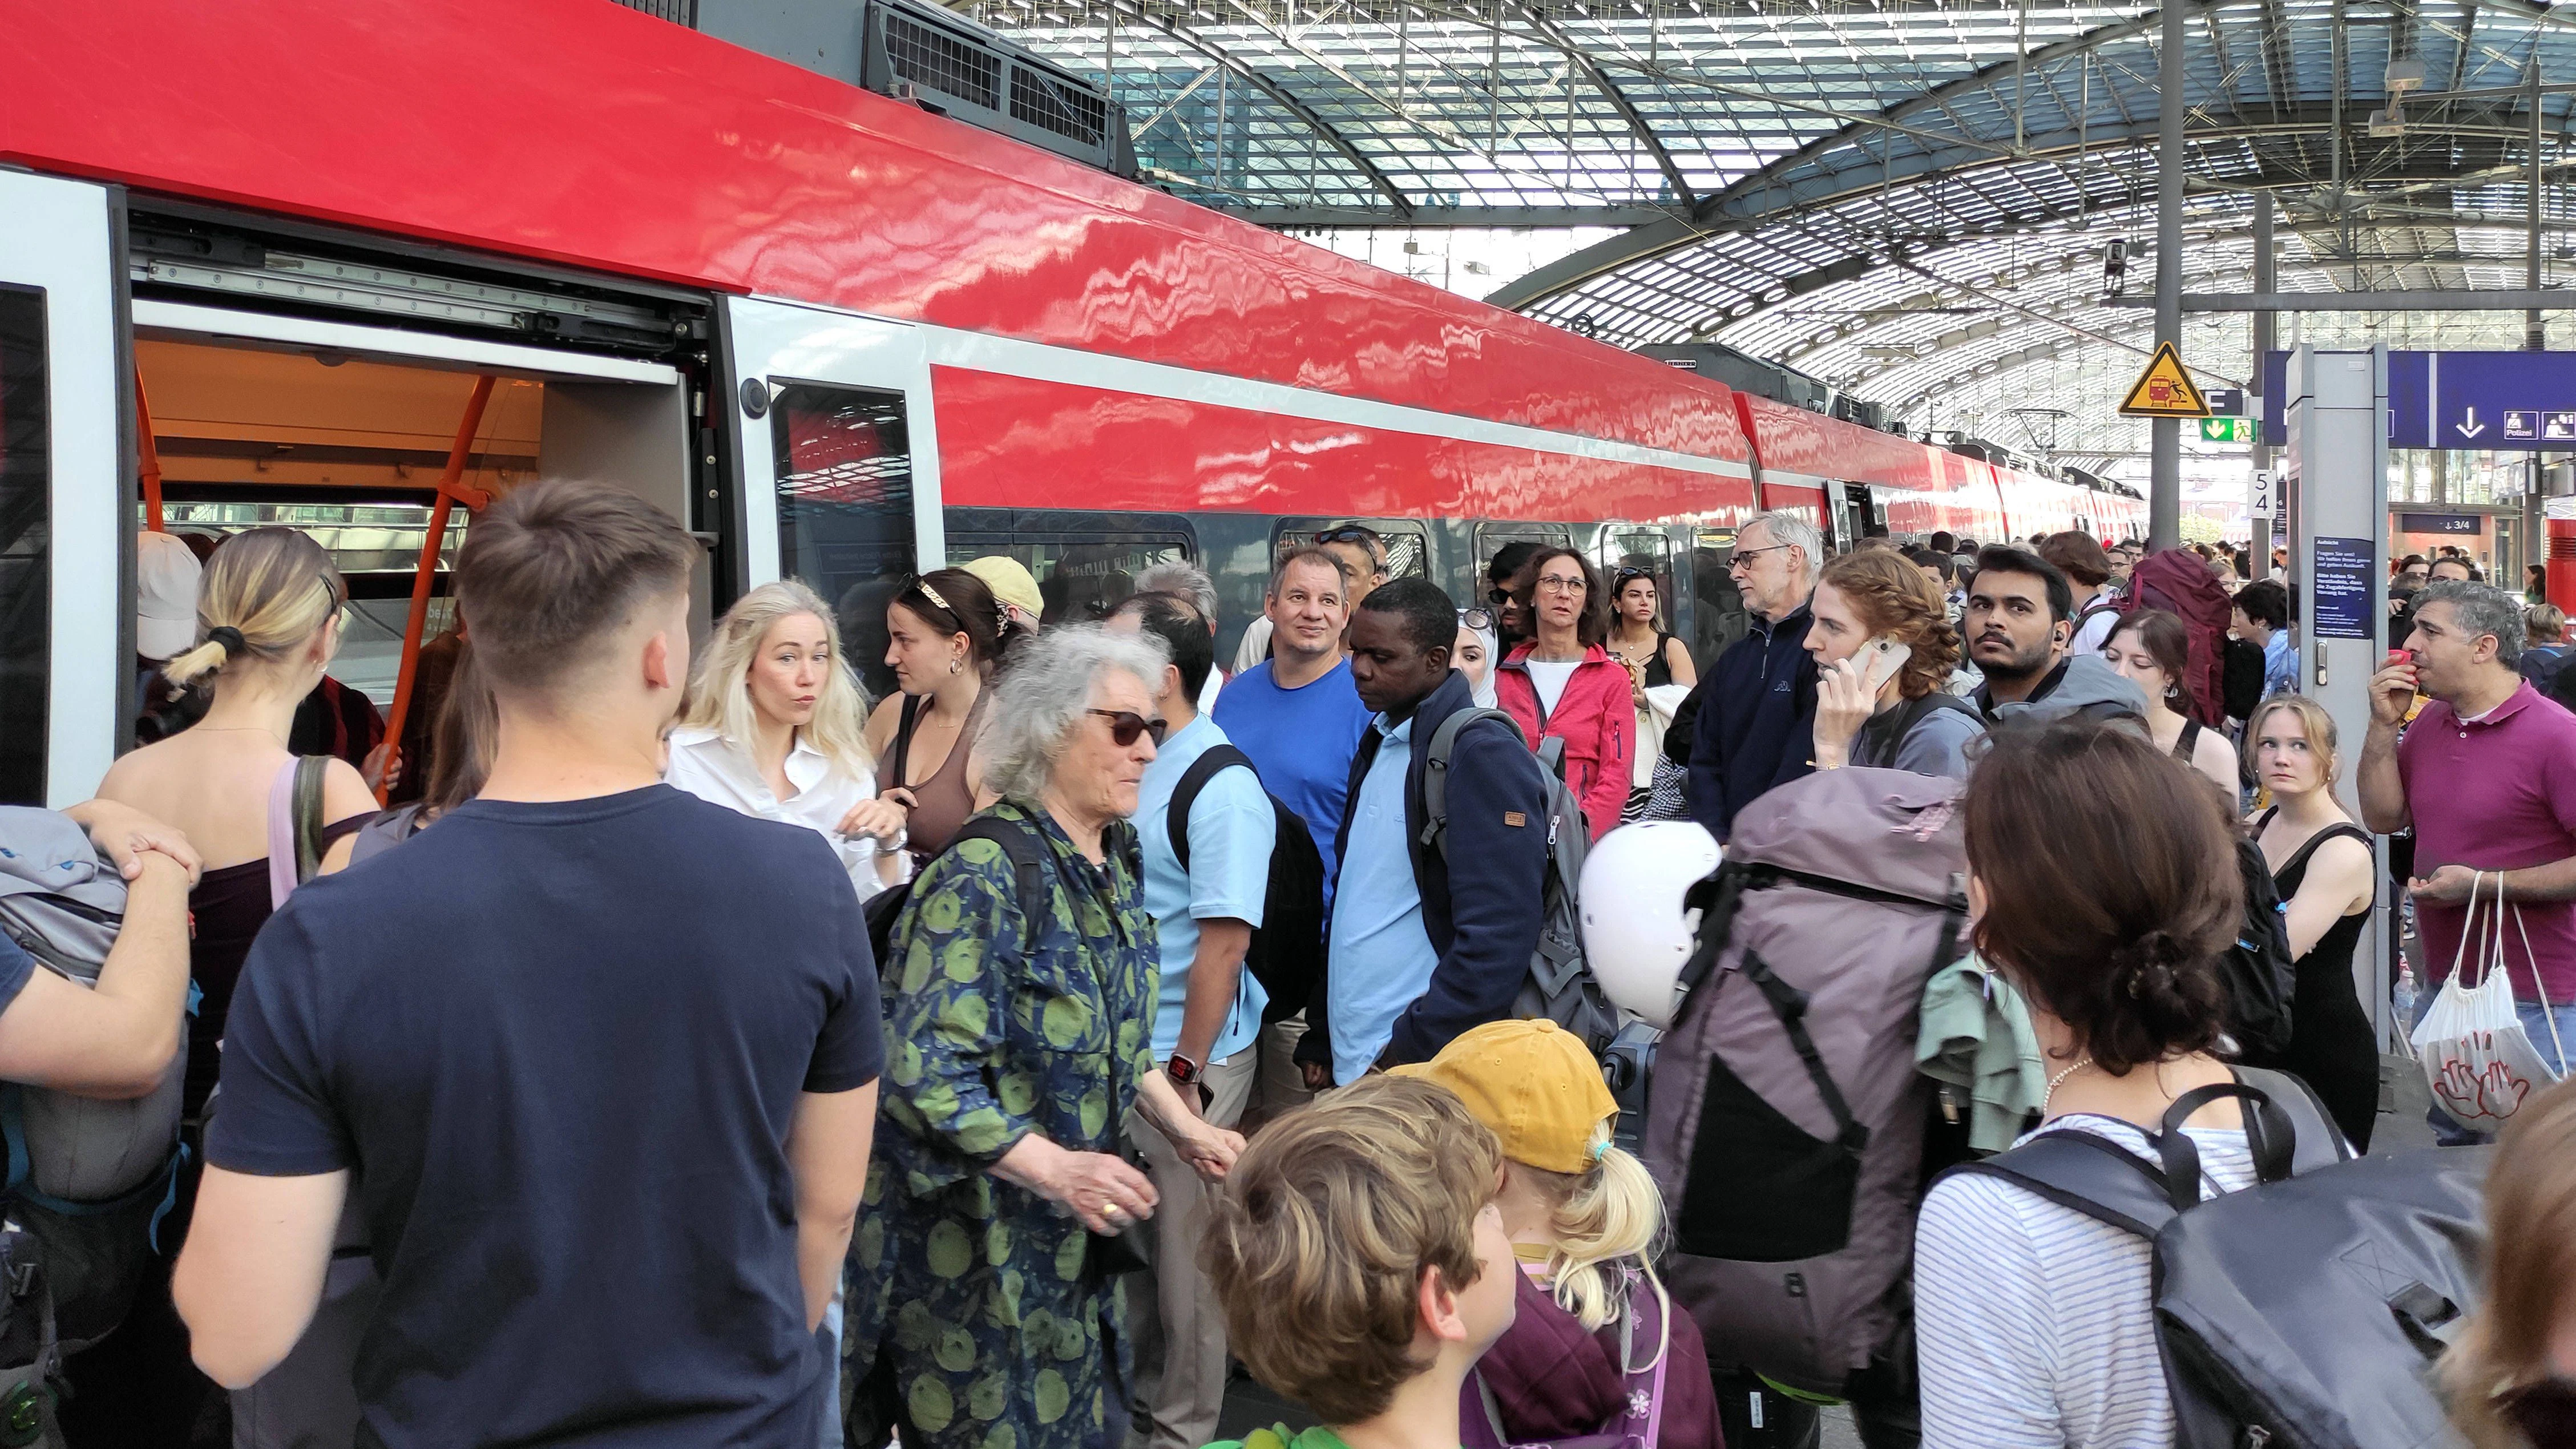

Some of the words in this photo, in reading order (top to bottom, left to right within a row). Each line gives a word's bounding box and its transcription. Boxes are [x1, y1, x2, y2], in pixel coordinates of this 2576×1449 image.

[2255, 474, 2268, 490] 5
[2255, 494, 2268, 511] 4
[2454, 520, 2470, 530] 3/4
